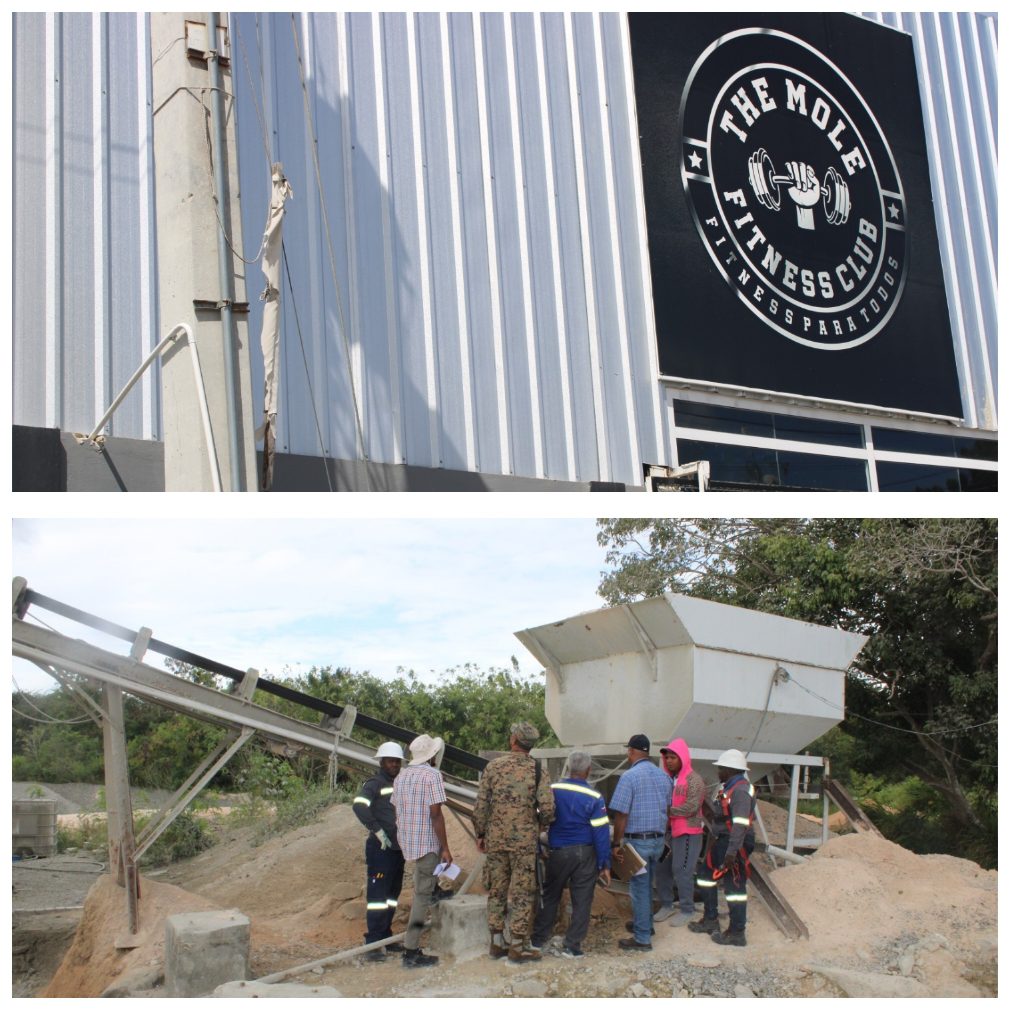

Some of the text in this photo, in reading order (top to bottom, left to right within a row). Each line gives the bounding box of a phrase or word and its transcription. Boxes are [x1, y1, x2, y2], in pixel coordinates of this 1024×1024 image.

[719, 76, 867, 176] THE MOLE
[705, 216, 899, 336] FITNESS PARA TODOS
[723, 188, 878, 299] FITNESS CLUB
